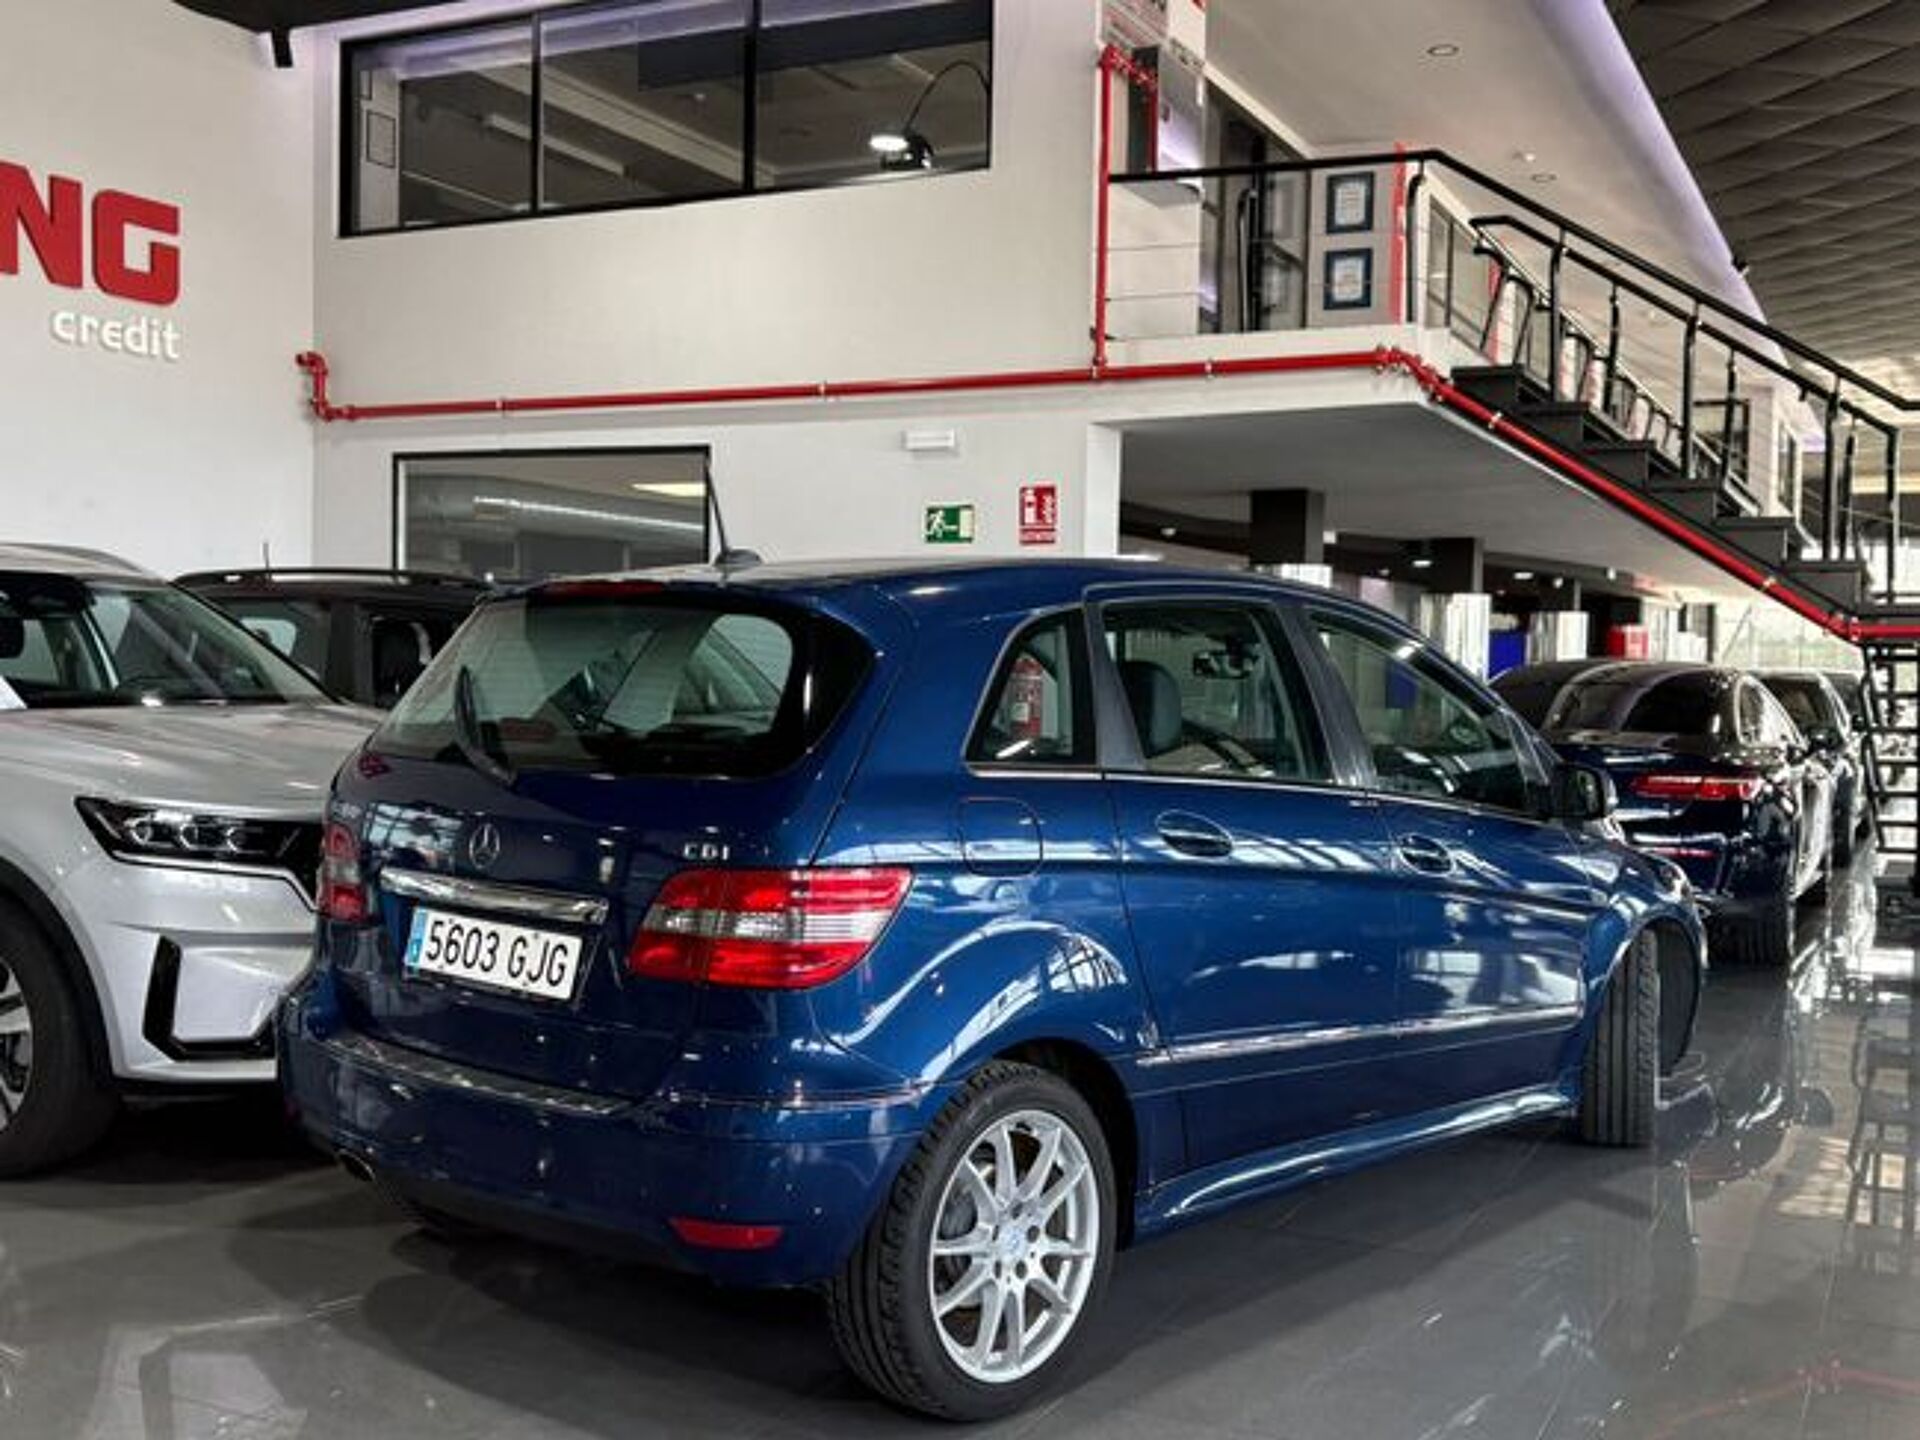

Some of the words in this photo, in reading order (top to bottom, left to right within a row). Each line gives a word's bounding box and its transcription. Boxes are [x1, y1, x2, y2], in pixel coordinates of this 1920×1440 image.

[0, 159, 180, 306] NG
[53, 309, 180, 359] credit
[683, 843, 729, 860] CDI
[426, 920, 500, 972] 5603
[508, 935, 568, 987] GJG
